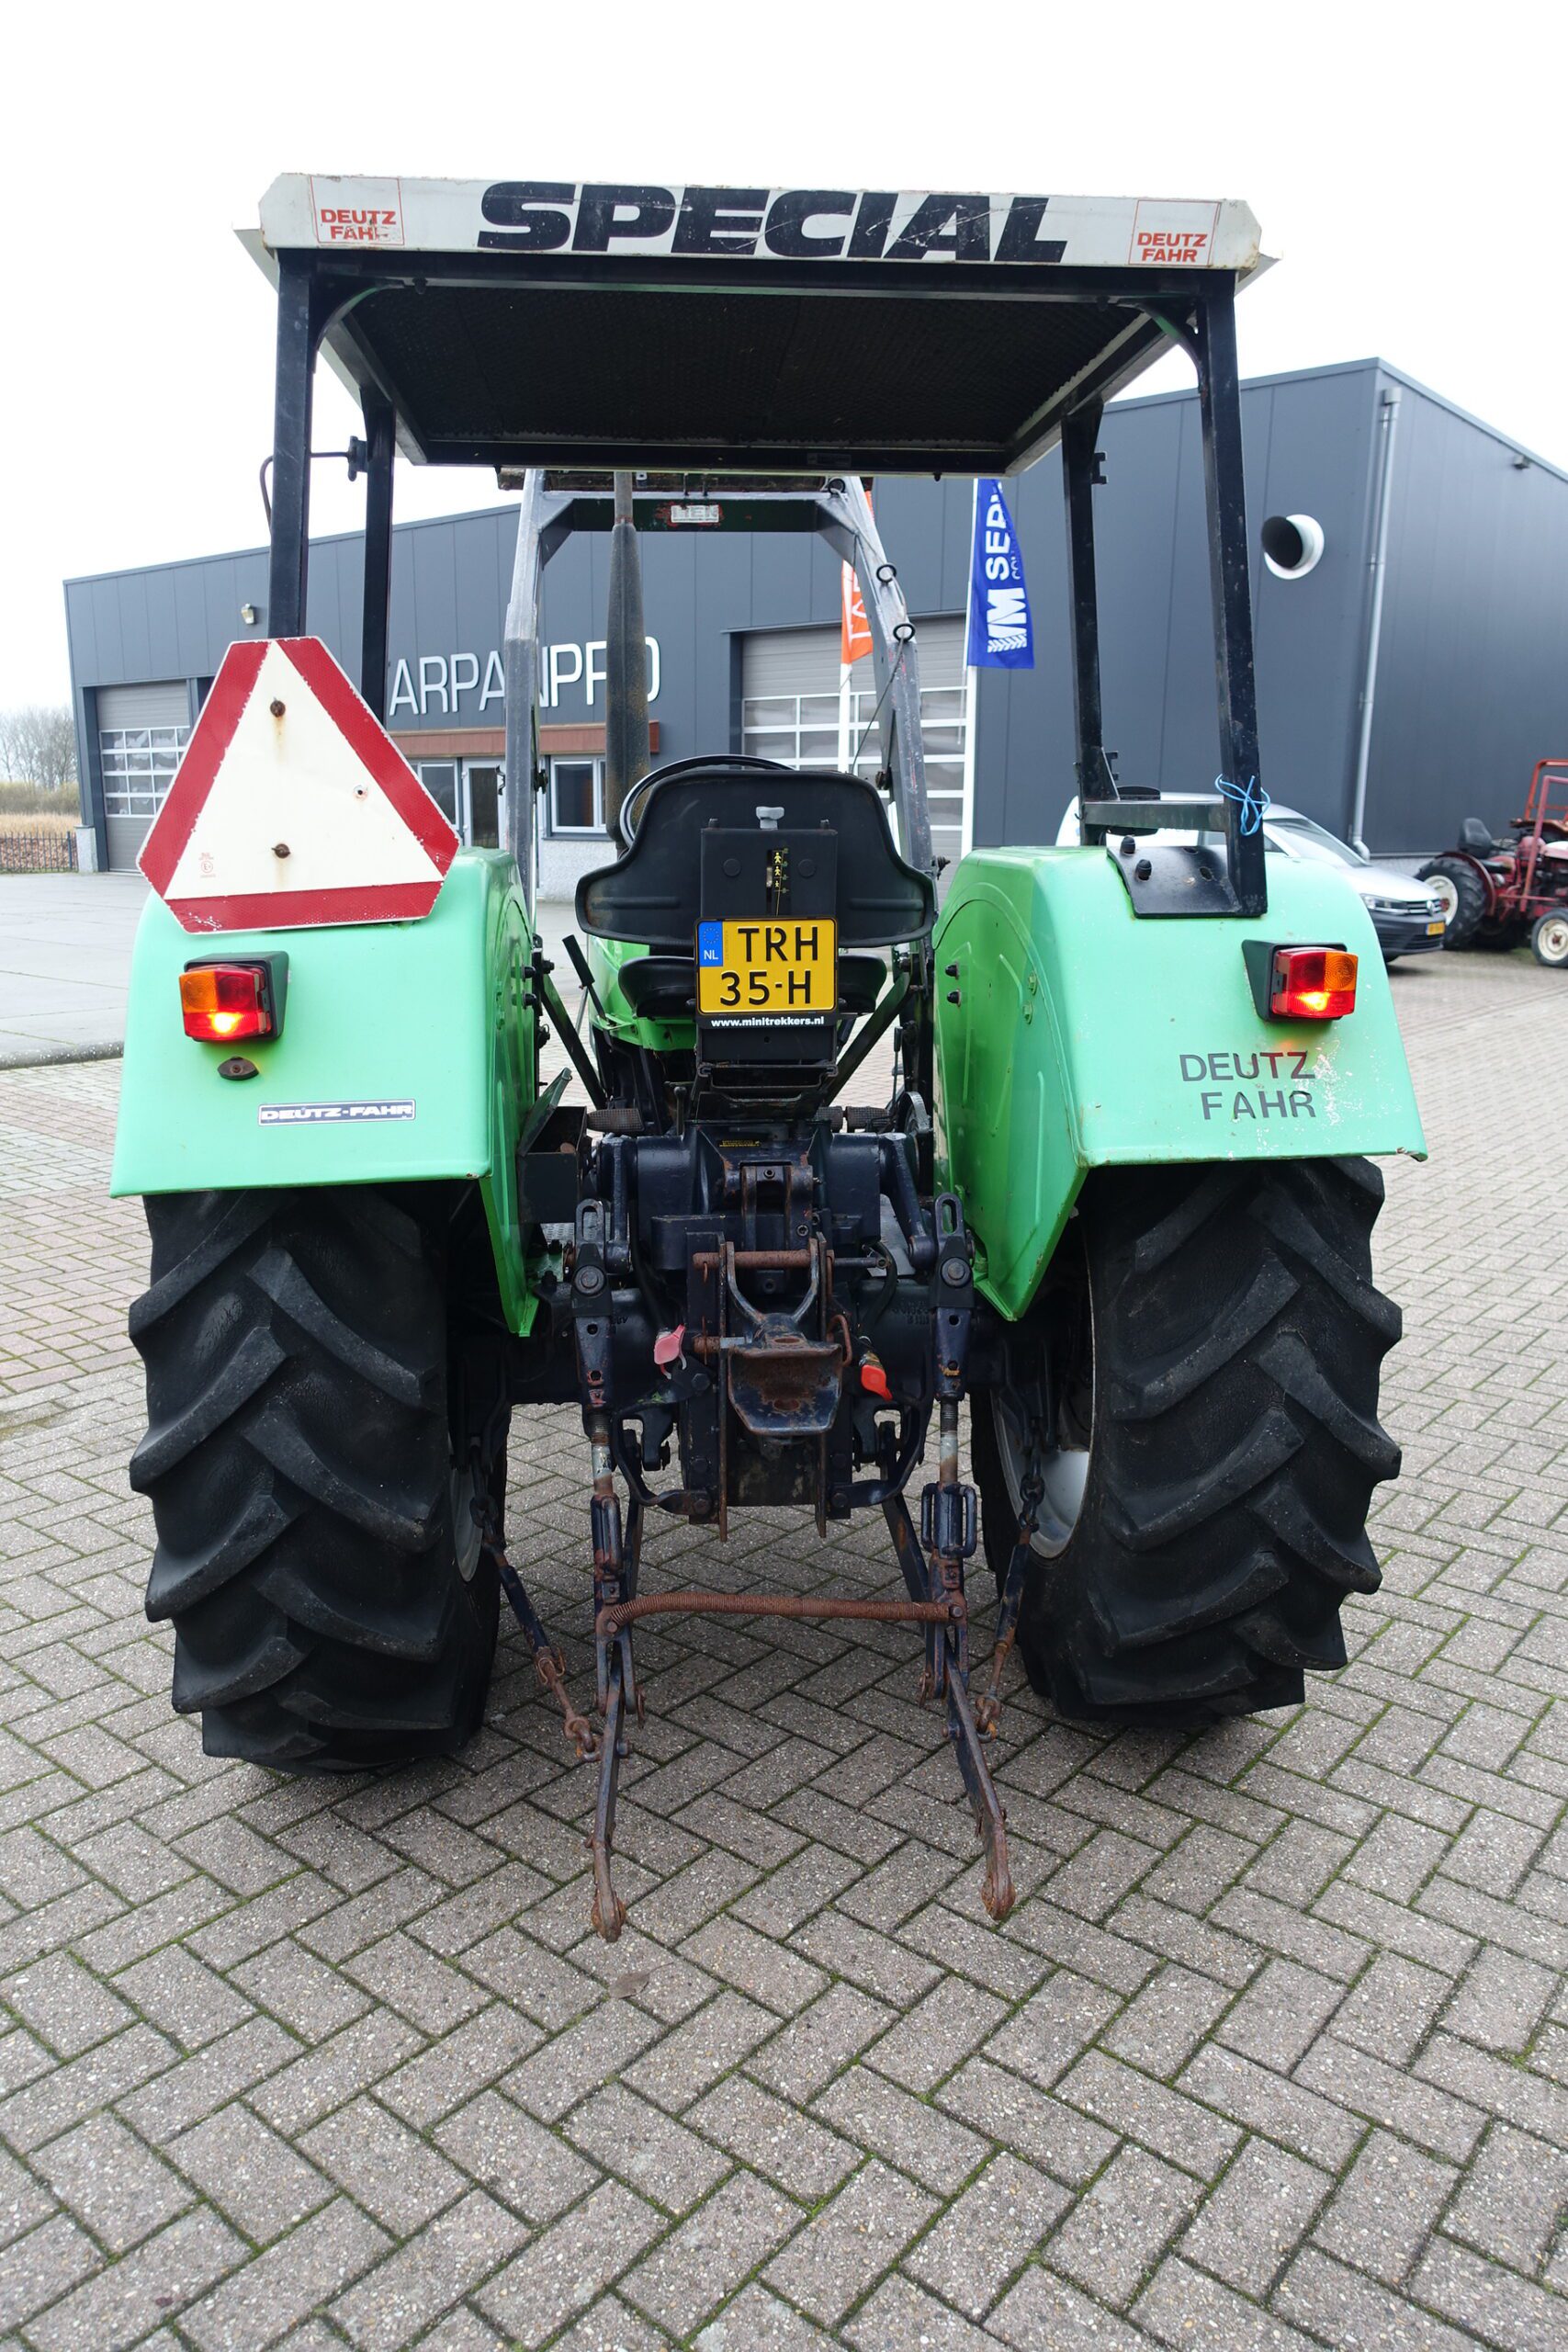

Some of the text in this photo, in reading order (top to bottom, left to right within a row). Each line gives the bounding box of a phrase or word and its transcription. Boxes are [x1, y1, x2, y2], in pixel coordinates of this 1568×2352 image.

[320, 209, 397, 225] DEUTZ
[477, 181, 1068, 264] SPECIAL
[1136, 232, 1208, 247] DEUTZ
[1141, 248, 1198, 263] FAHR
[738, 926, 818, 962] TRH
[704, 950, 719, 960] NL
[719, 970, 811, 1006] 35-H
[711, 1016, 825, 1027] www.minitrekkers.nl
[1179, 1050, 1316, 1082] DEUTZ
[260, 1104, 413, 1121] DEUTZ-FAHR
[1200, 1090, 1317, 1120] FAHR
